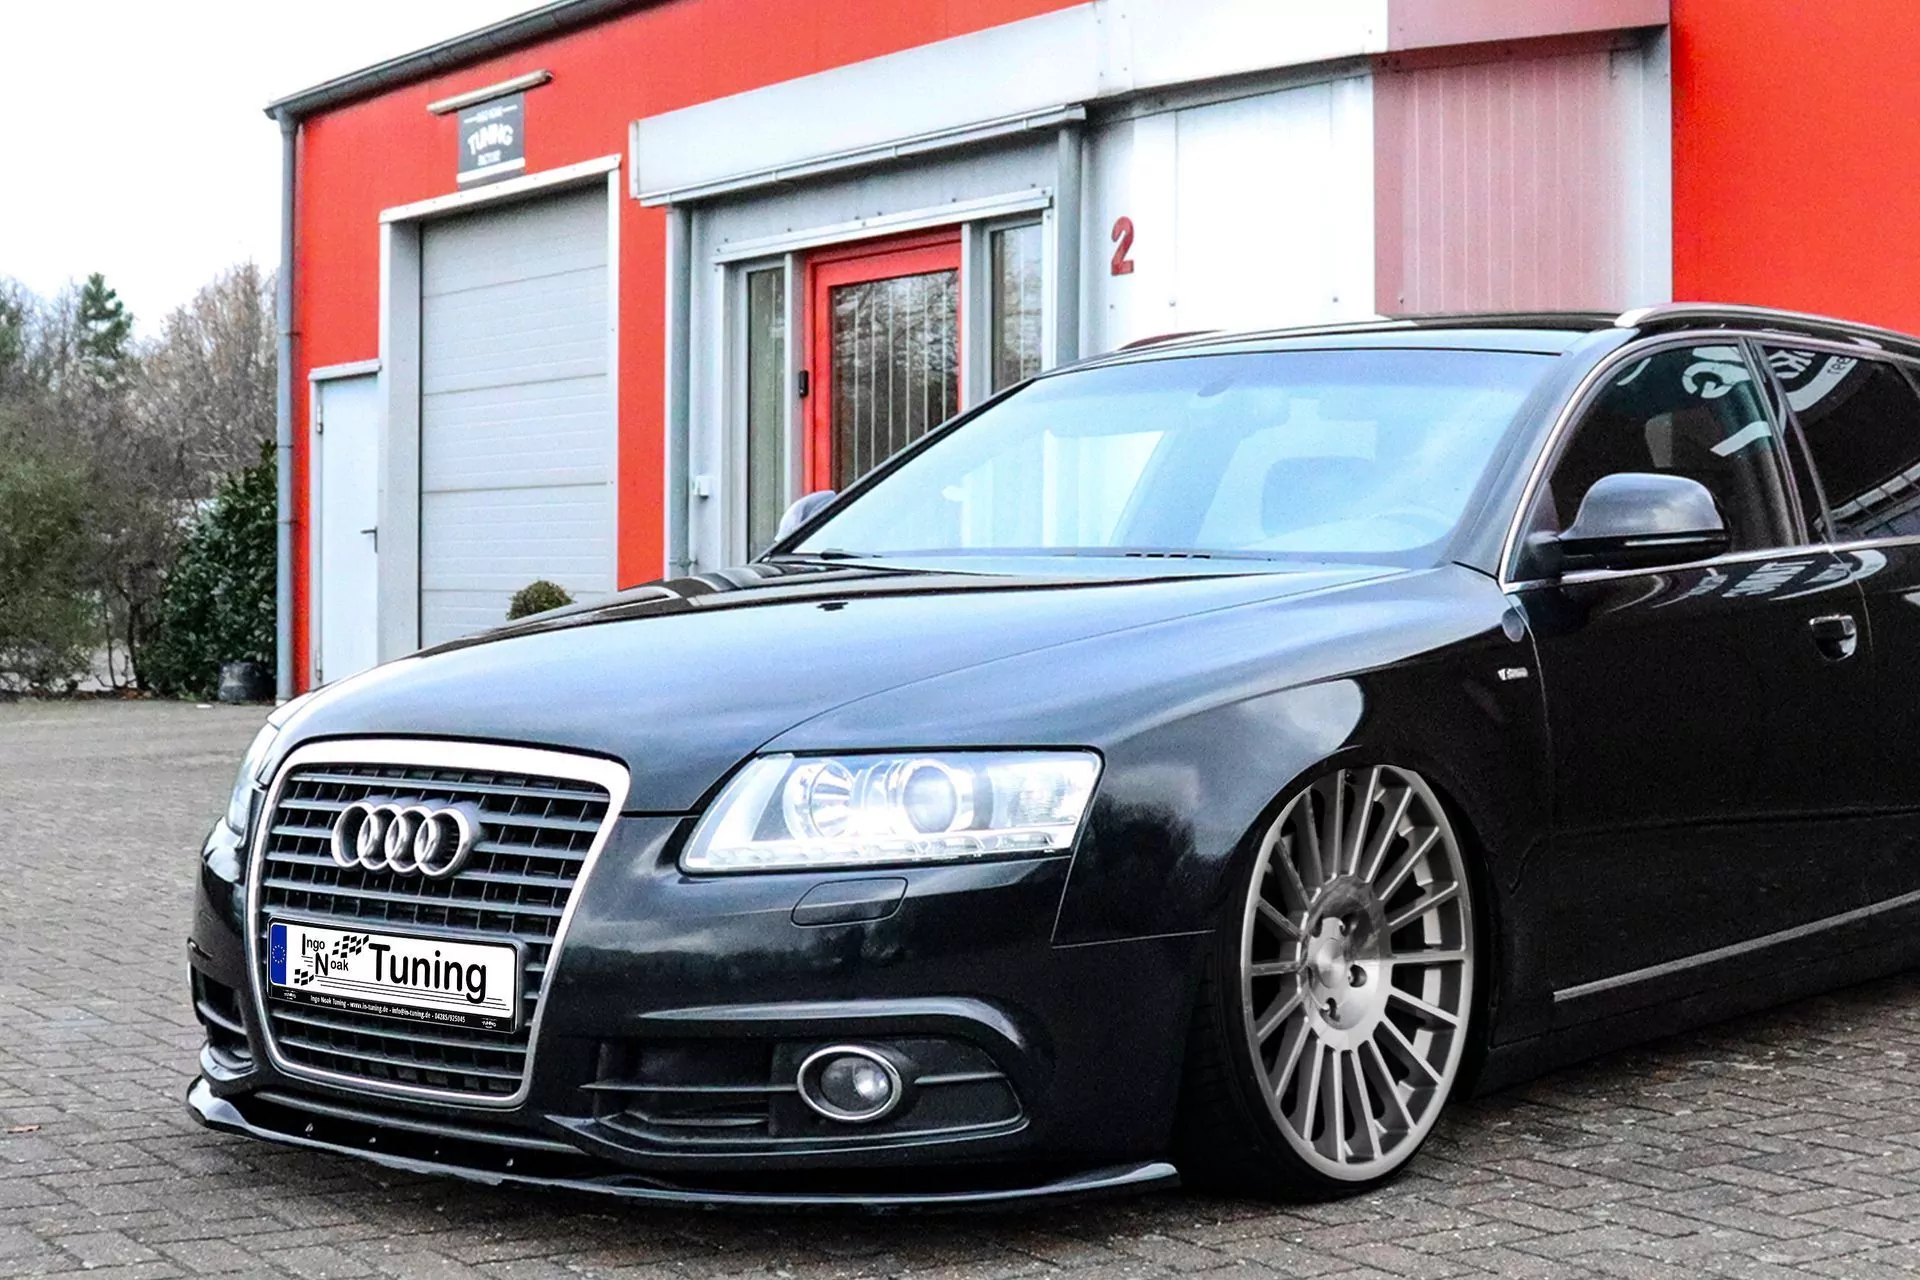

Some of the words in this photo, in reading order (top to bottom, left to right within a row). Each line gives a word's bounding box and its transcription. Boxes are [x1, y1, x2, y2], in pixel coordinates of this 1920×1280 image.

[1111, 216, 1134, 276] 2
[301, 933, 326, 956] Ingo
[315, 952, 349, 976] Noak
[368, 943, 487, 1004] Tuning
